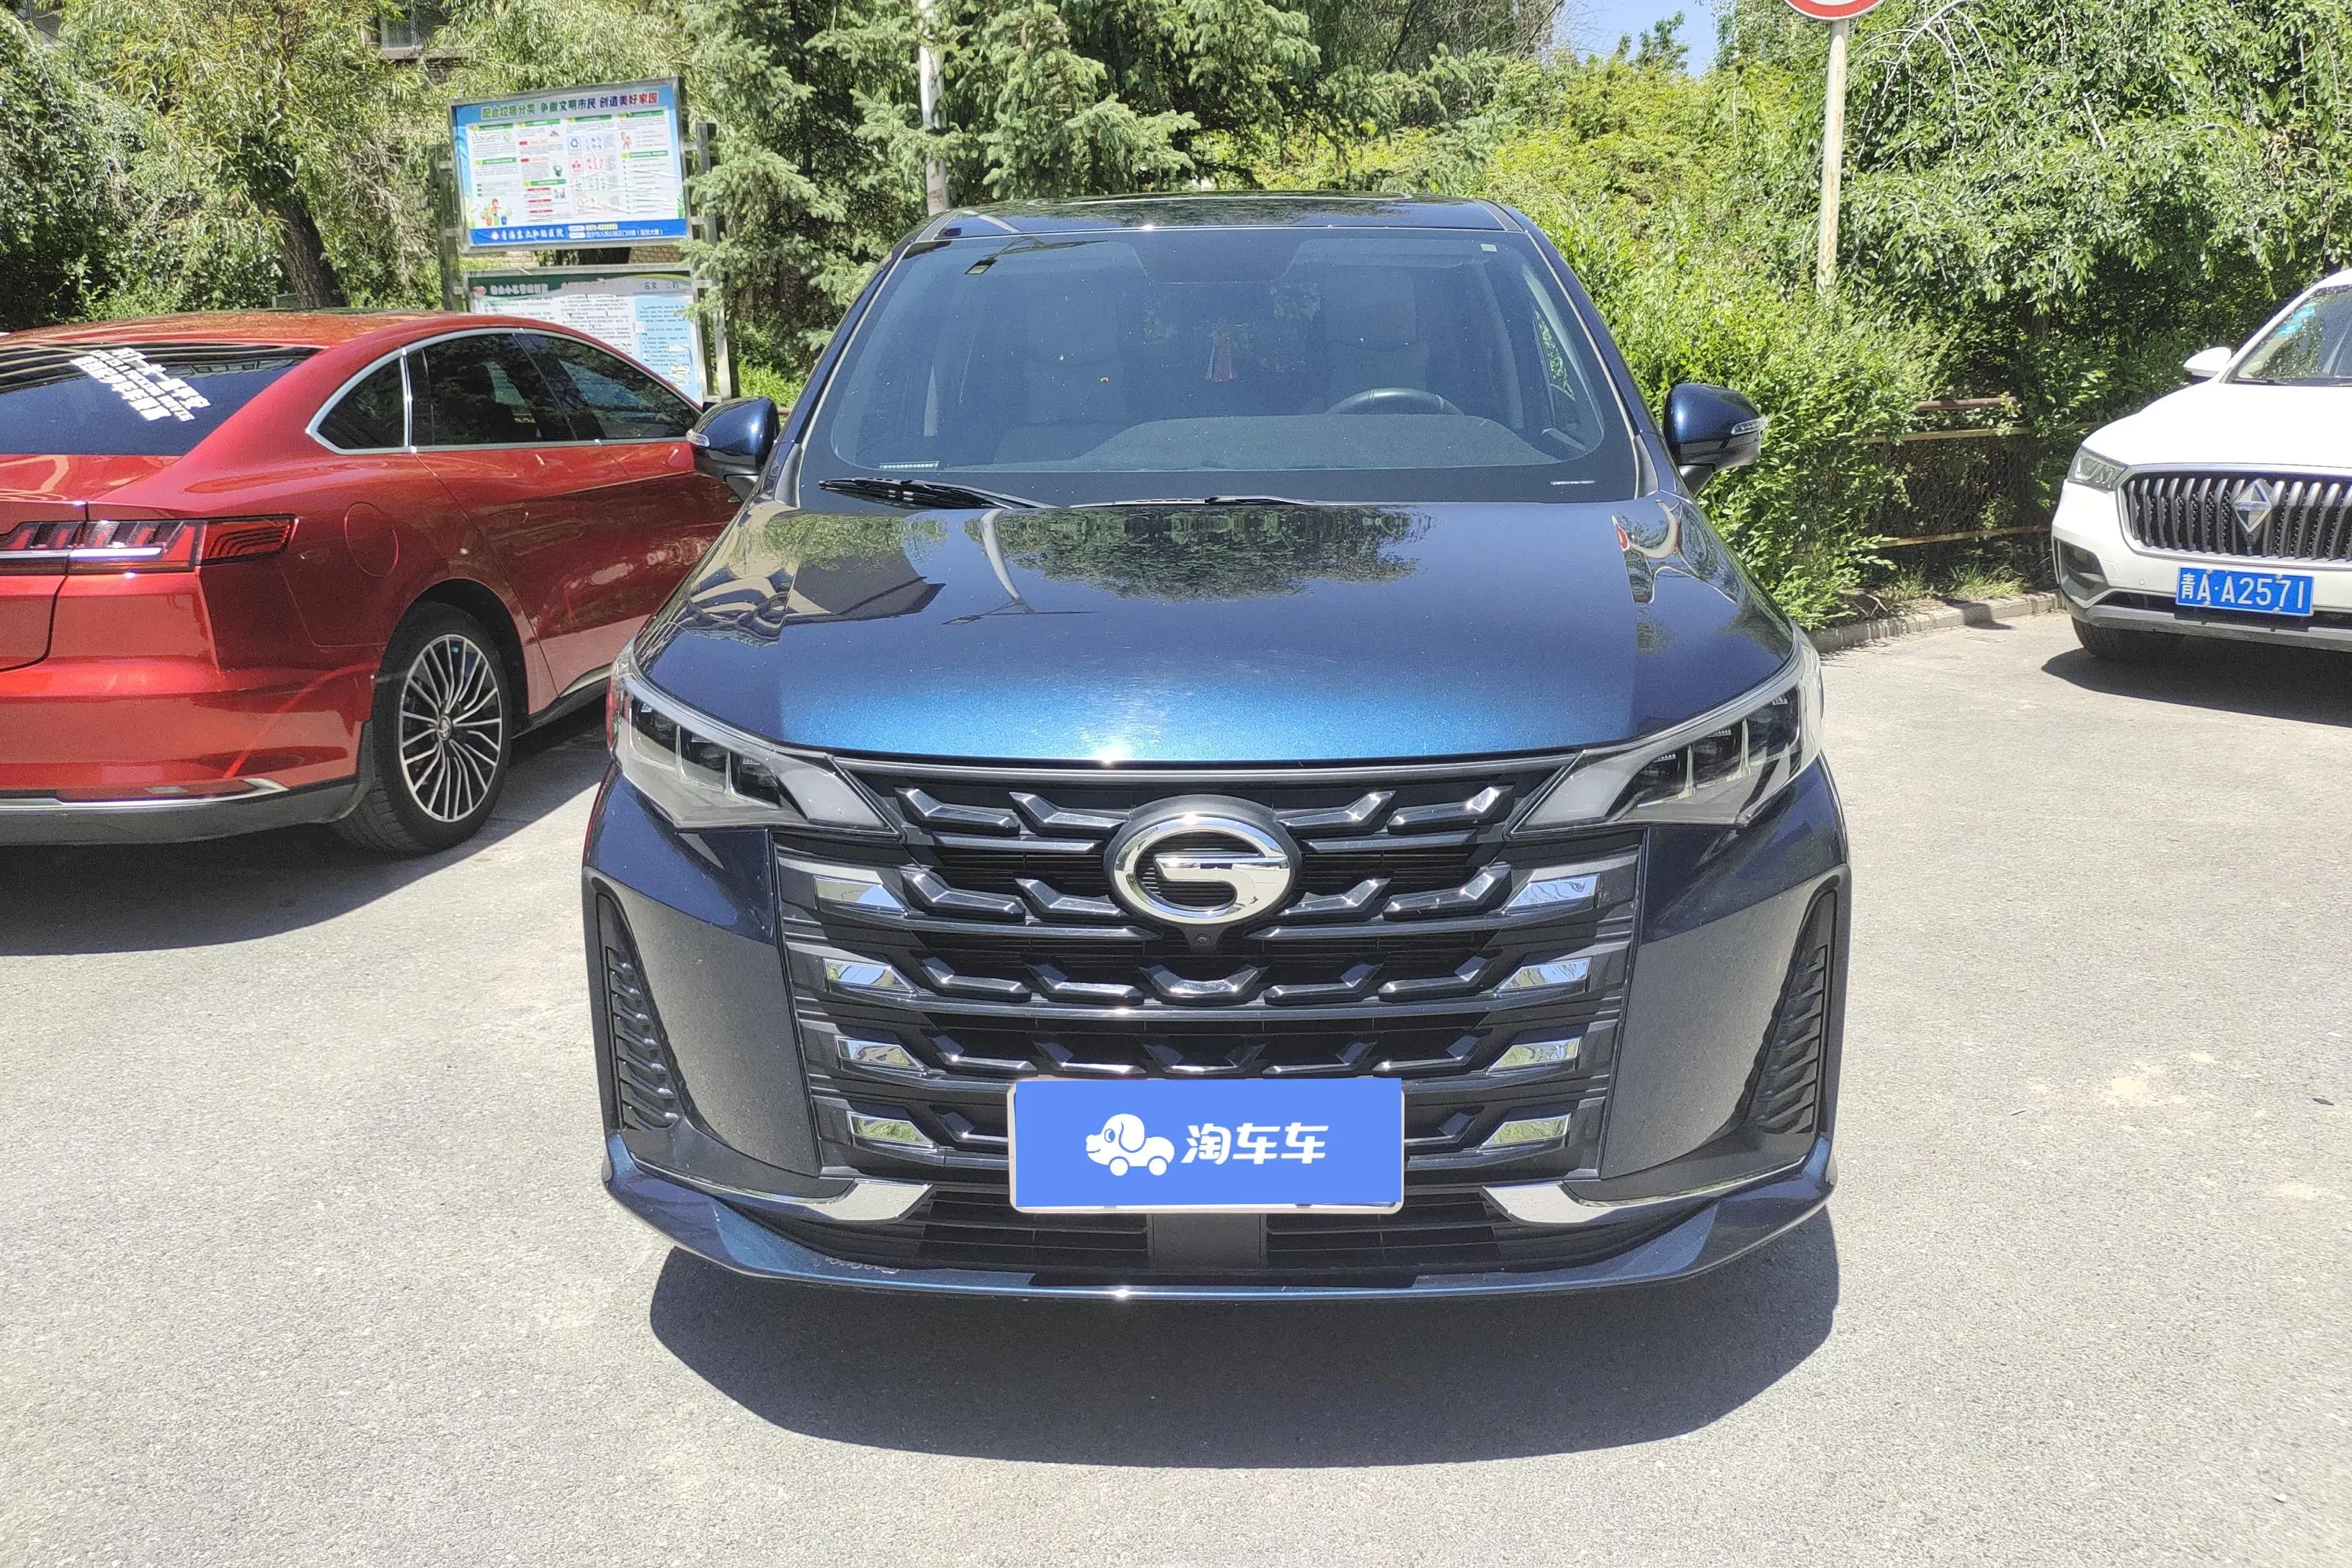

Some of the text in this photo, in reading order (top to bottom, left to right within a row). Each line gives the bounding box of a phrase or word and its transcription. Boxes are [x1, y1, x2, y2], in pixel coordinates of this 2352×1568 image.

[540, 98, 596, 112] 争做文明市民
[600, 92, 657, 108] 创造美好家园
